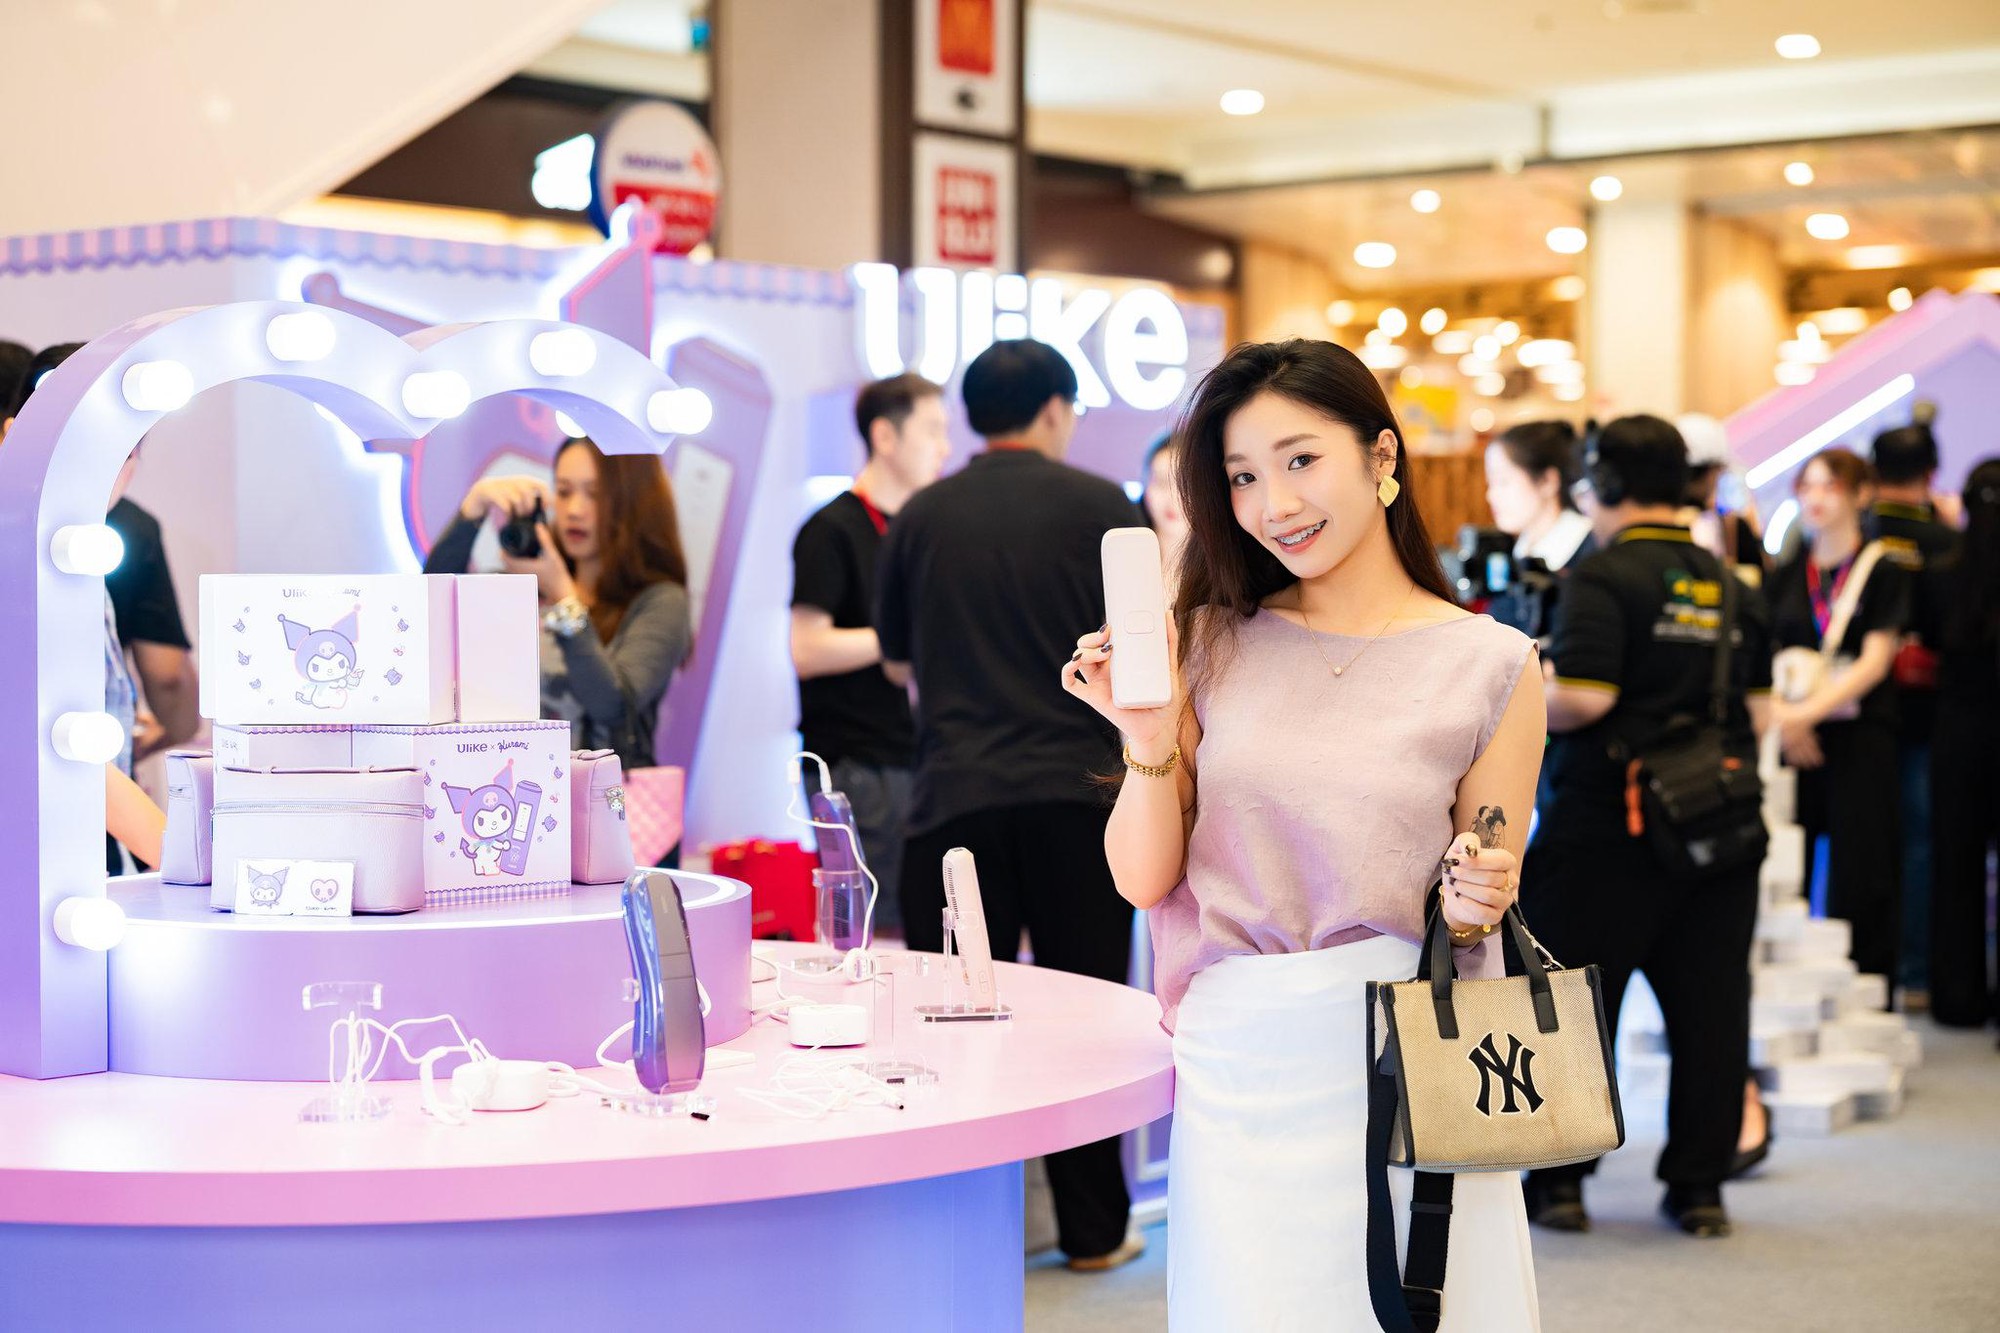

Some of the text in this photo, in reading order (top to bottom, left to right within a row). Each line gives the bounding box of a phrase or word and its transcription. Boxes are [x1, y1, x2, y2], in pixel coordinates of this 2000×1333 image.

[850, 262, 1188, 411] Ulike
[282, 588, 308, 598] Ulik
[1467, 1032, 1545, 1116] NY
